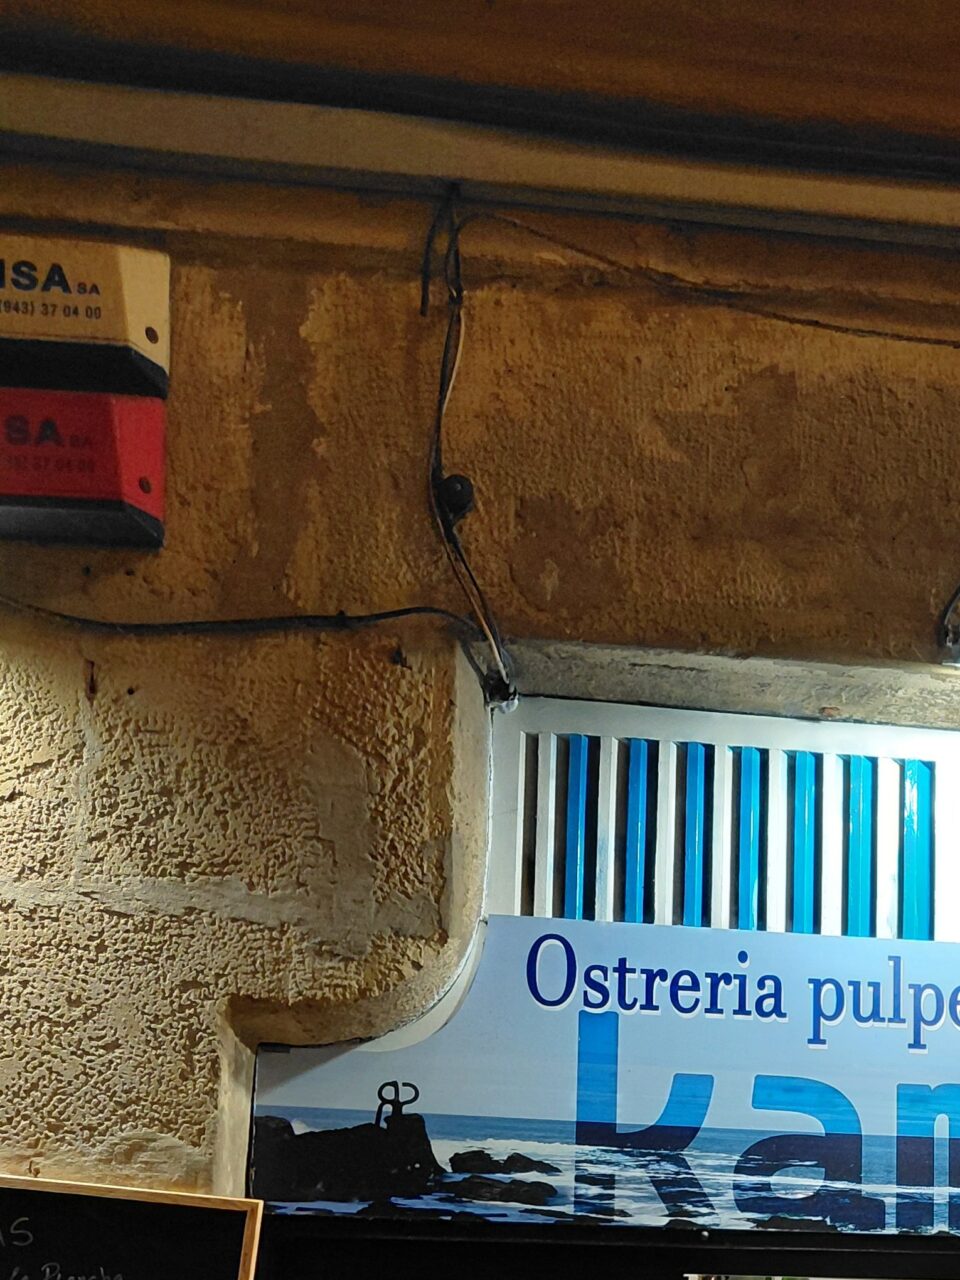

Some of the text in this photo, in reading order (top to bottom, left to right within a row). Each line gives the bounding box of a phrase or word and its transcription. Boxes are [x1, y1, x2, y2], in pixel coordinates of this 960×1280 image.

[0, 258, 100, 295] SA SA
[41, 303, 57, 317] 37
[63, 305, 79, 318] 04
[85, 305, 102, 320] 00
[526, 932, 788, 1019] Ostreria
[0, 1216, 34, 1247] S
